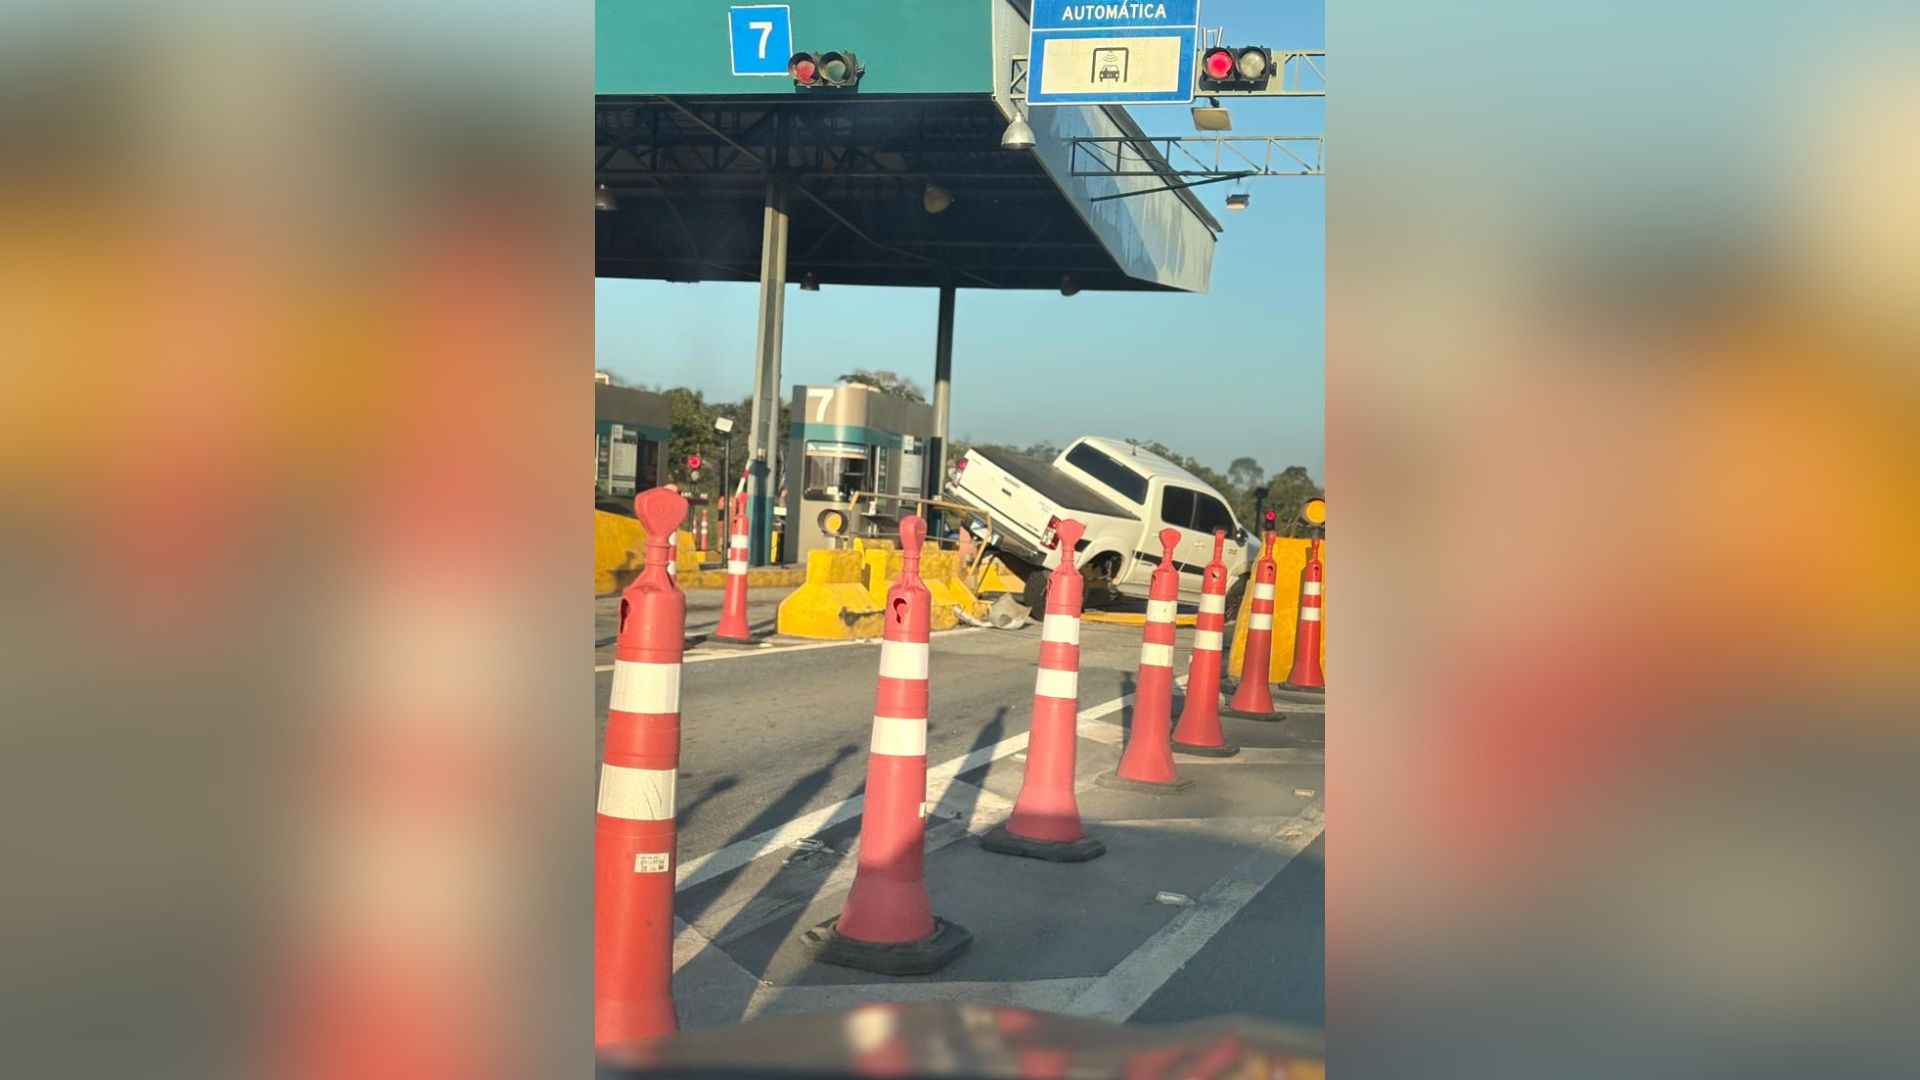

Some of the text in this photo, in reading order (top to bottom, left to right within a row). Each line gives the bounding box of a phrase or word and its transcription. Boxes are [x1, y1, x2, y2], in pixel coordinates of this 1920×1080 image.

[1061, 0, 1167, 21] AUTOMÁTICA
[749, 21, 773, 59] 7
[808, 388, 834, 423] 7
